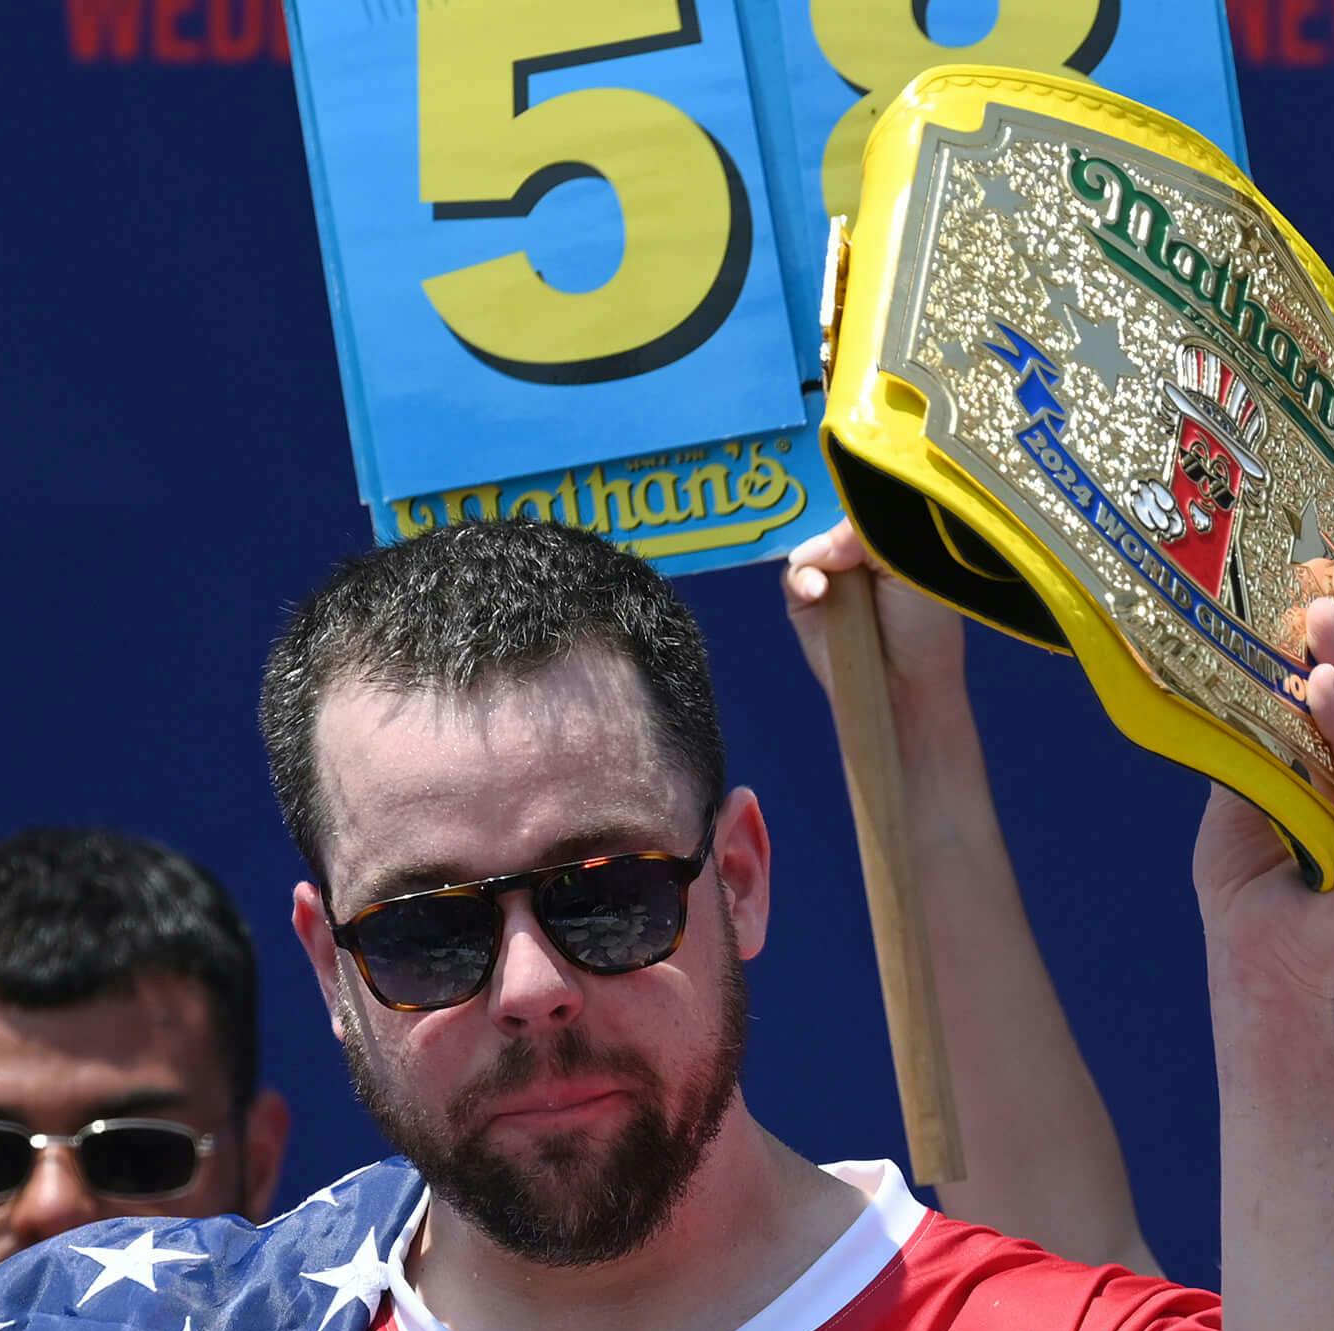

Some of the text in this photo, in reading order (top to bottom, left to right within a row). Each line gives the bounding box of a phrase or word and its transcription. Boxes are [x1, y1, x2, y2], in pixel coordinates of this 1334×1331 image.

[418, 0, 753, 385] 5
[1024, 430, 1311, 702] 2024 WORLD CHAMPIO
